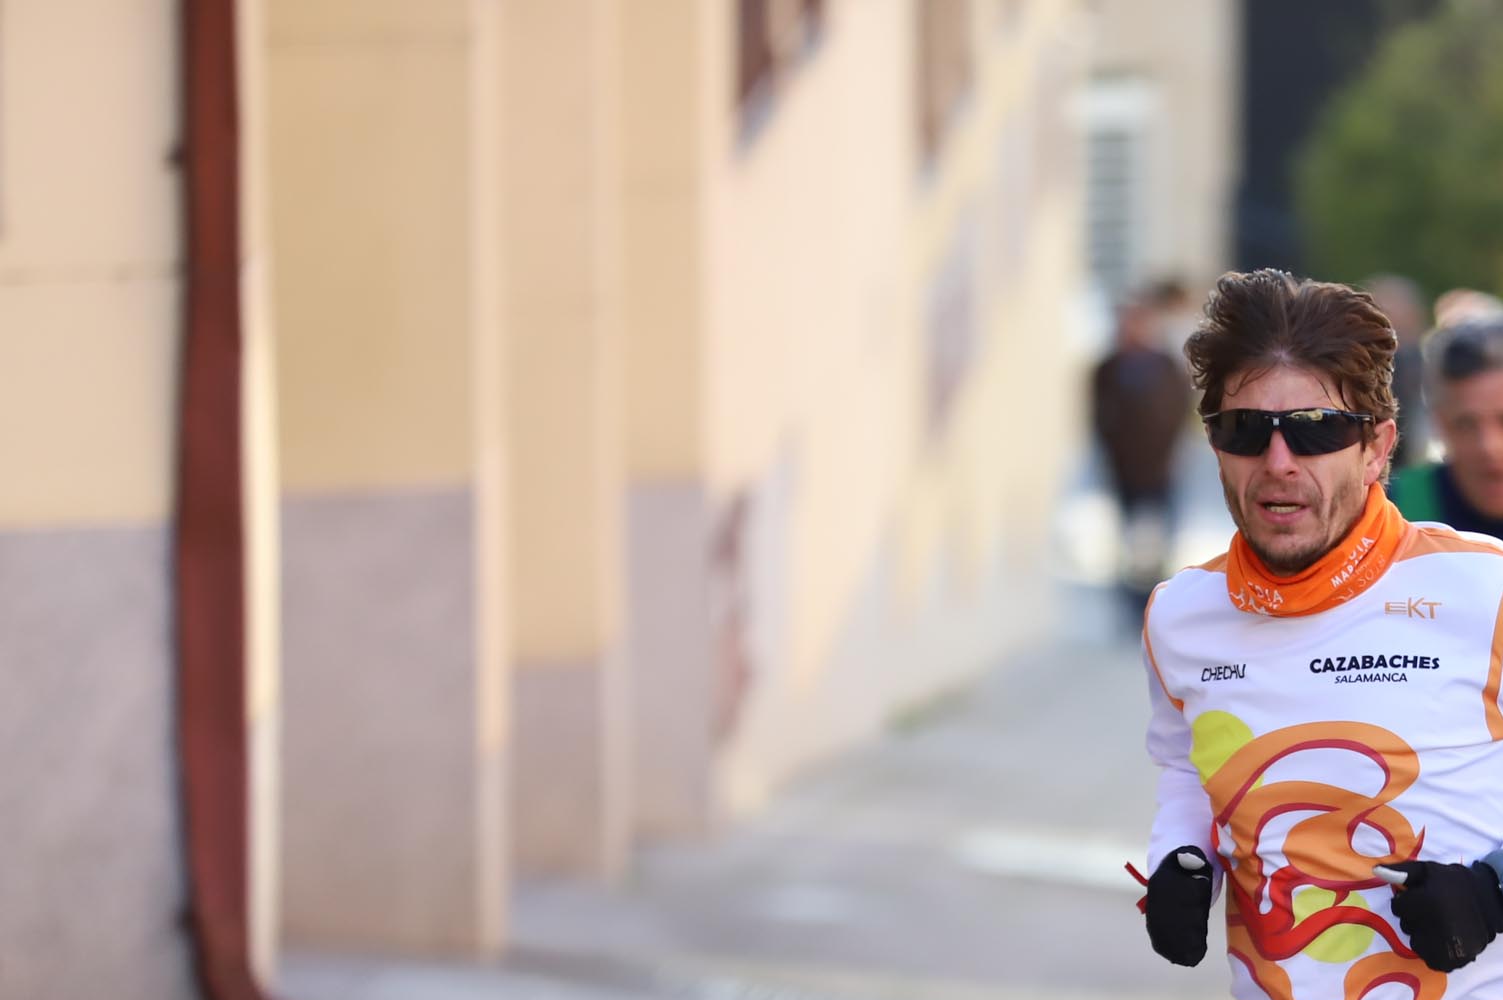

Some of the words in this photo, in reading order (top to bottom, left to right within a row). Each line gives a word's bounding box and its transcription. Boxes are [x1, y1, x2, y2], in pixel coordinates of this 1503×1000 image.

[1384, 597, 1442, 619] EKT
[1201, 663, 1246, 682] CHECHU
[1309, 654, 1440, 673] CAZABACHES
[1334, 672, 1408, 684] SALAMANCA
